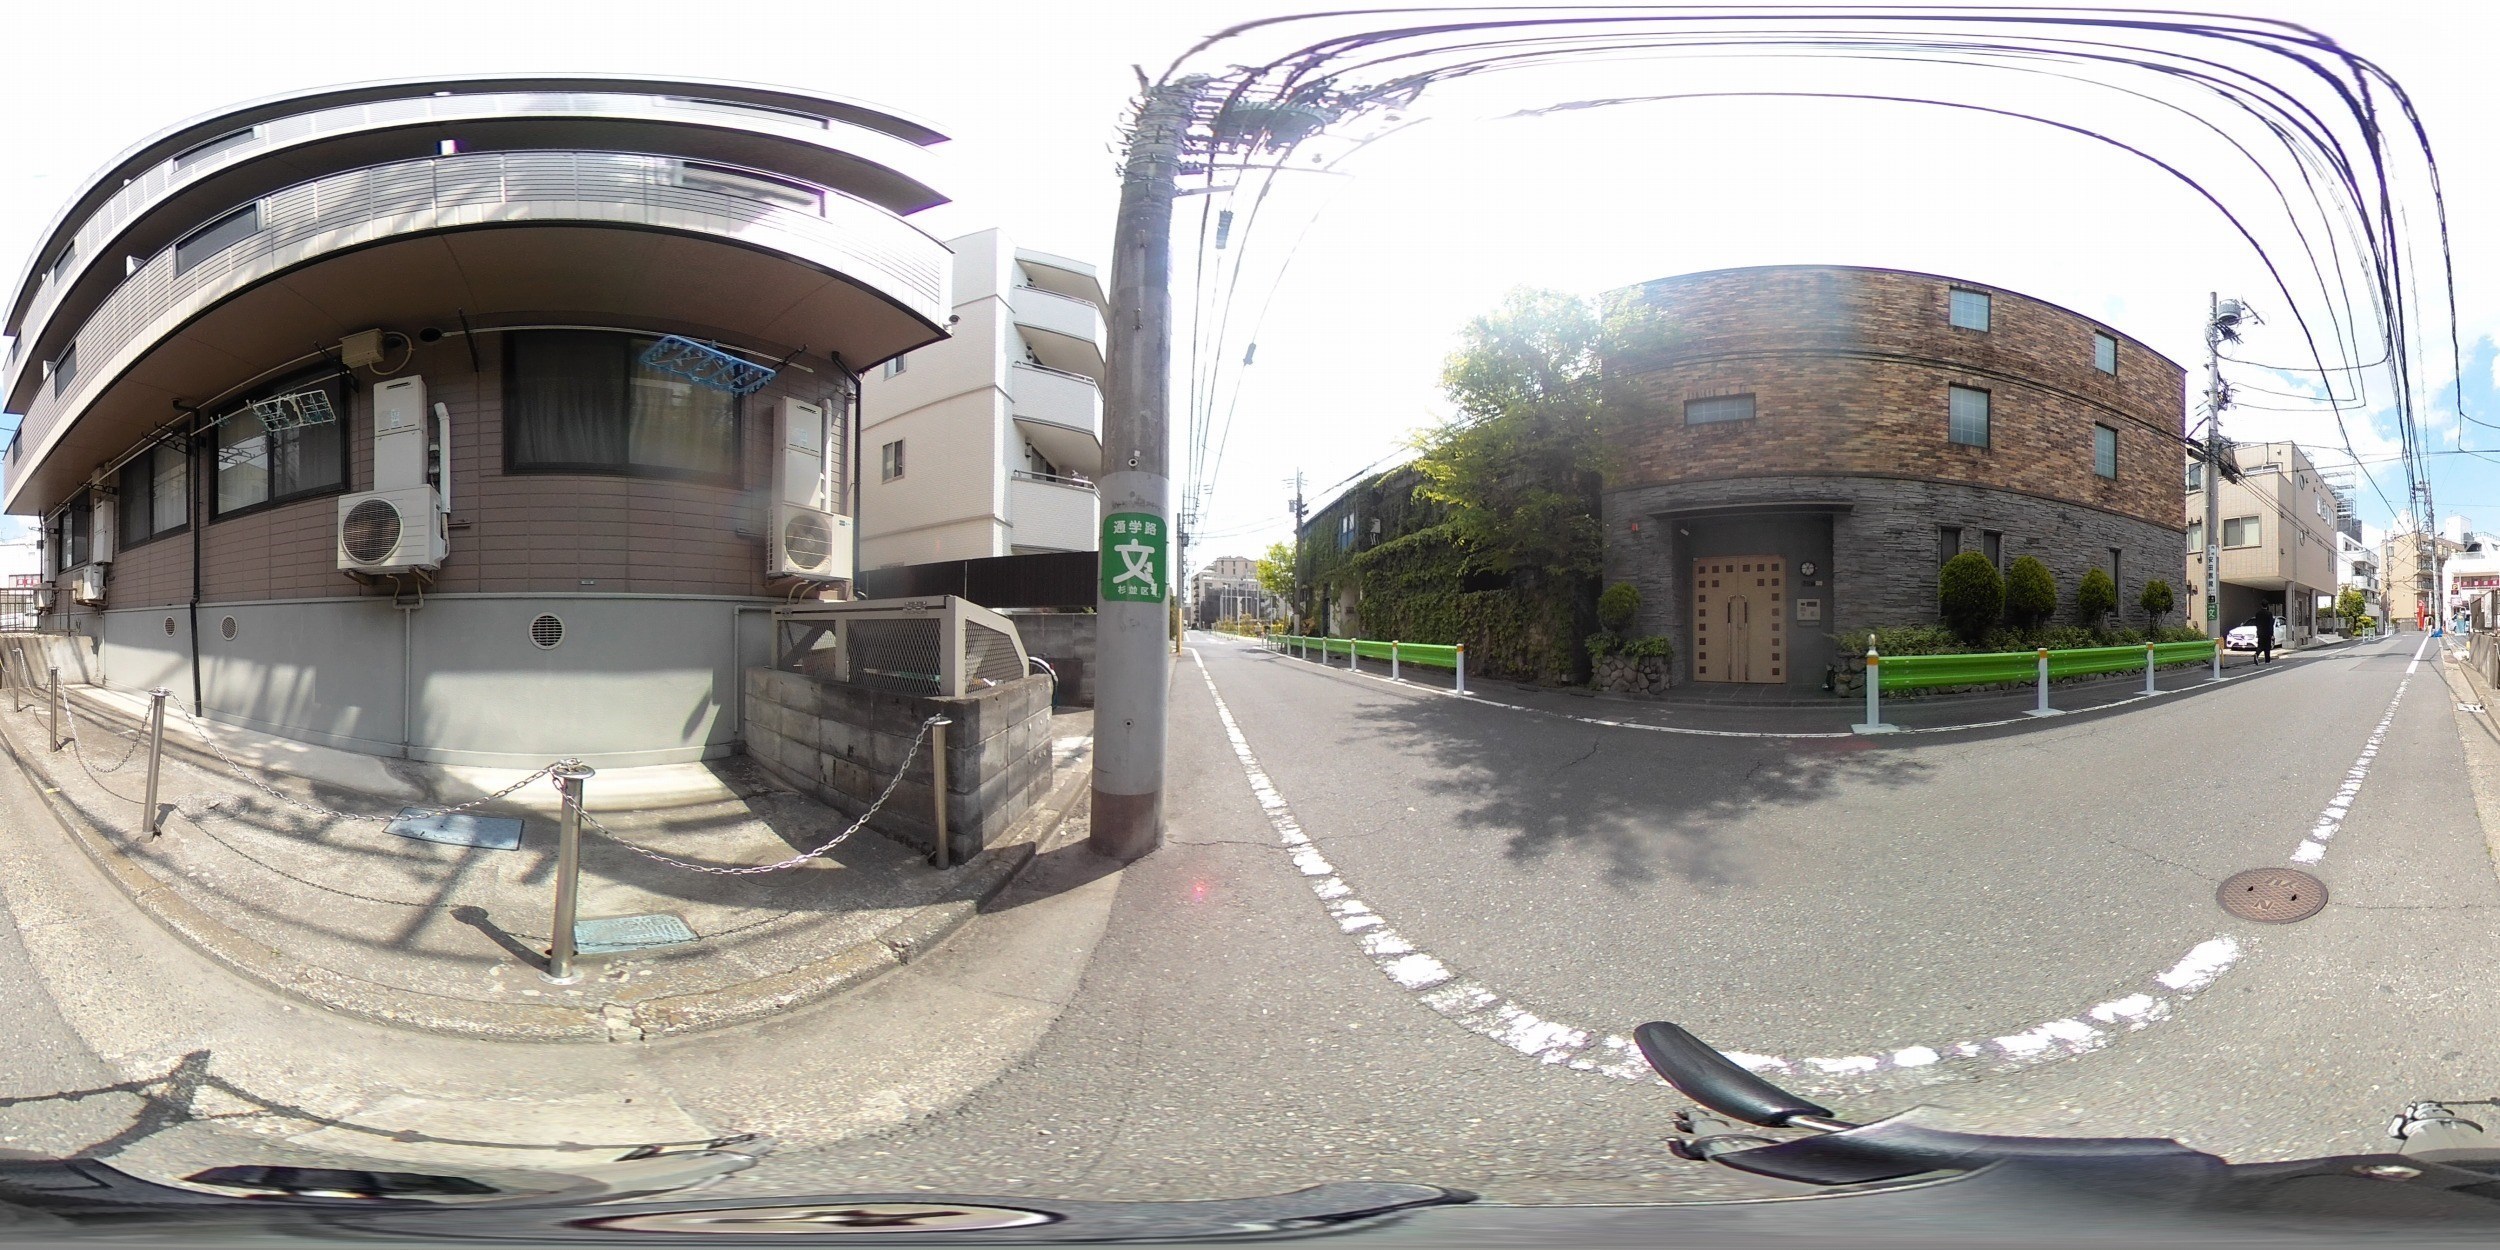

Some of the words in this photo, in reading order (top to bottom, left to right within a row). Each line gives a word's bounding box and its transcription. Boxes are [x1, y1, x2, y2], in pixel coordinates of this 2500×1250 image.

[1113, 520, 1156, 535] 通学路
[1113, 538, 1155, 585] 文
[1117, 585, 1149, 595] 杉並区
